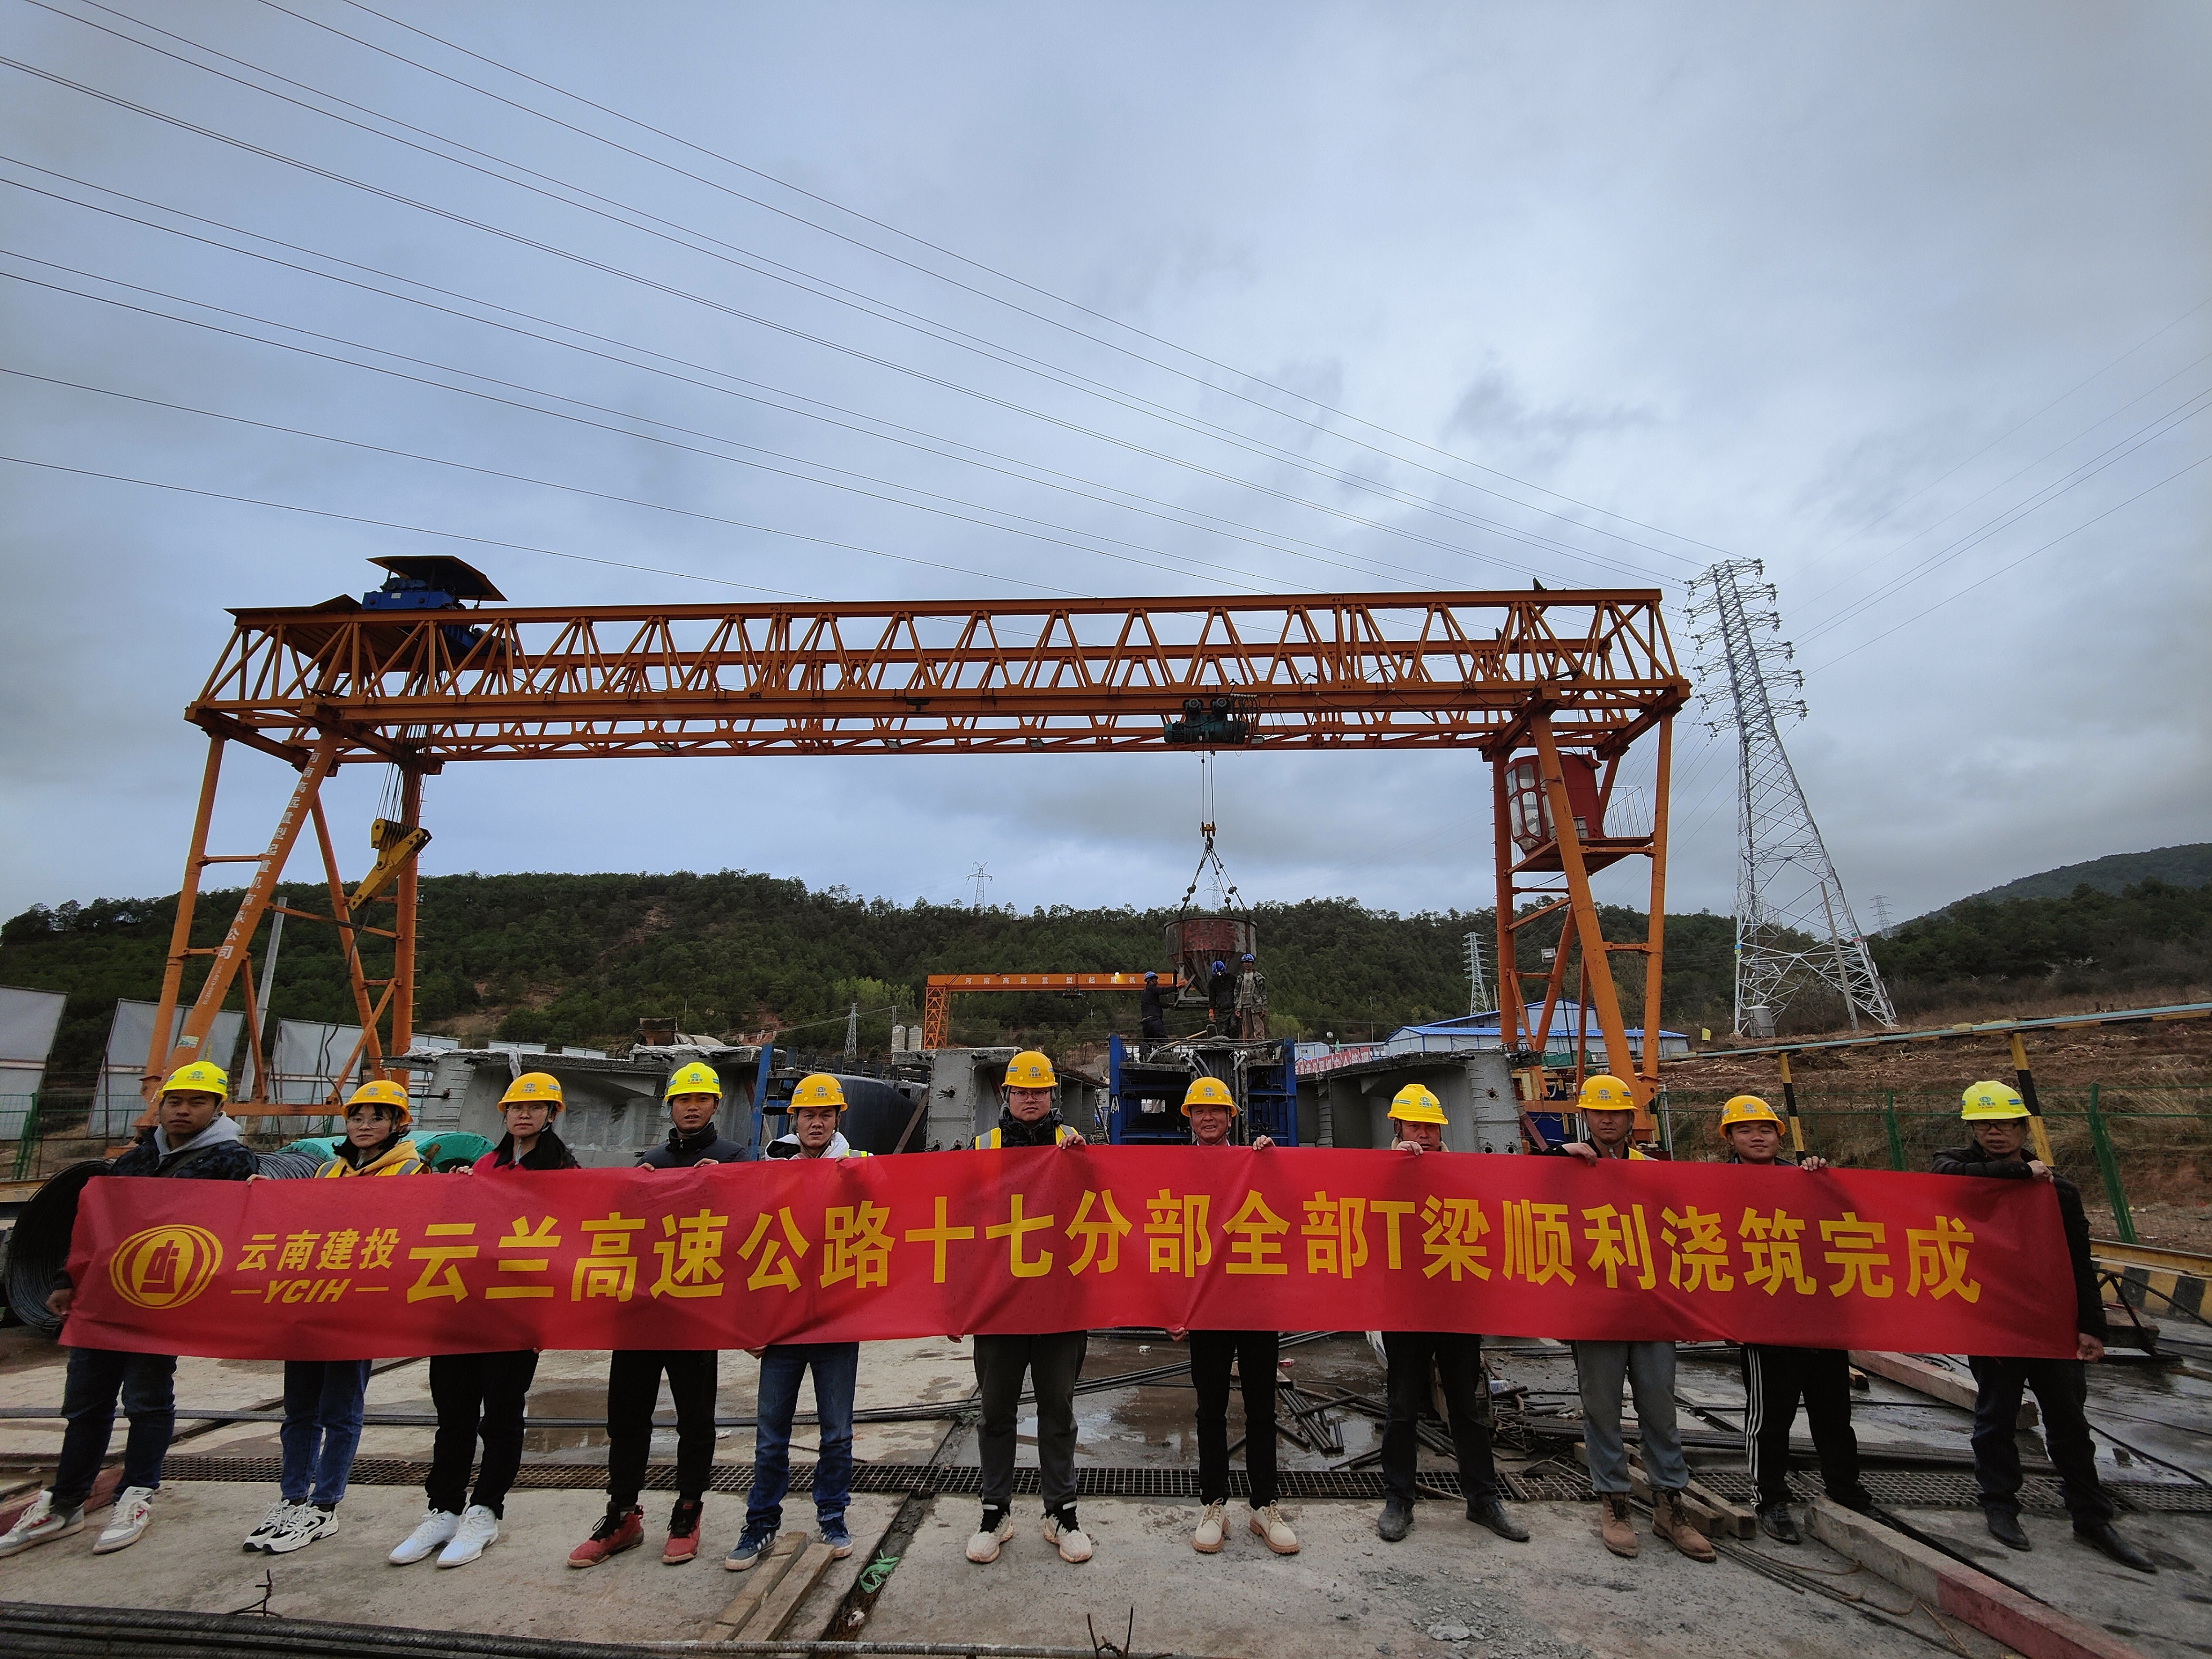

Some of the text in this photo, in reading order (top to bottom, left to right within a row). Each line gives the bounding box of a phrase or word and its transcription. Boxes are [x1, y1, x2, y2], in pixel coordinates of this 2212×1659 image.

[238, 1228, 399, 1270] 云南建投
[407, 1190, 1979, 1302] 云兰高速公路十七分部全部T梁顺利浇筑完成
